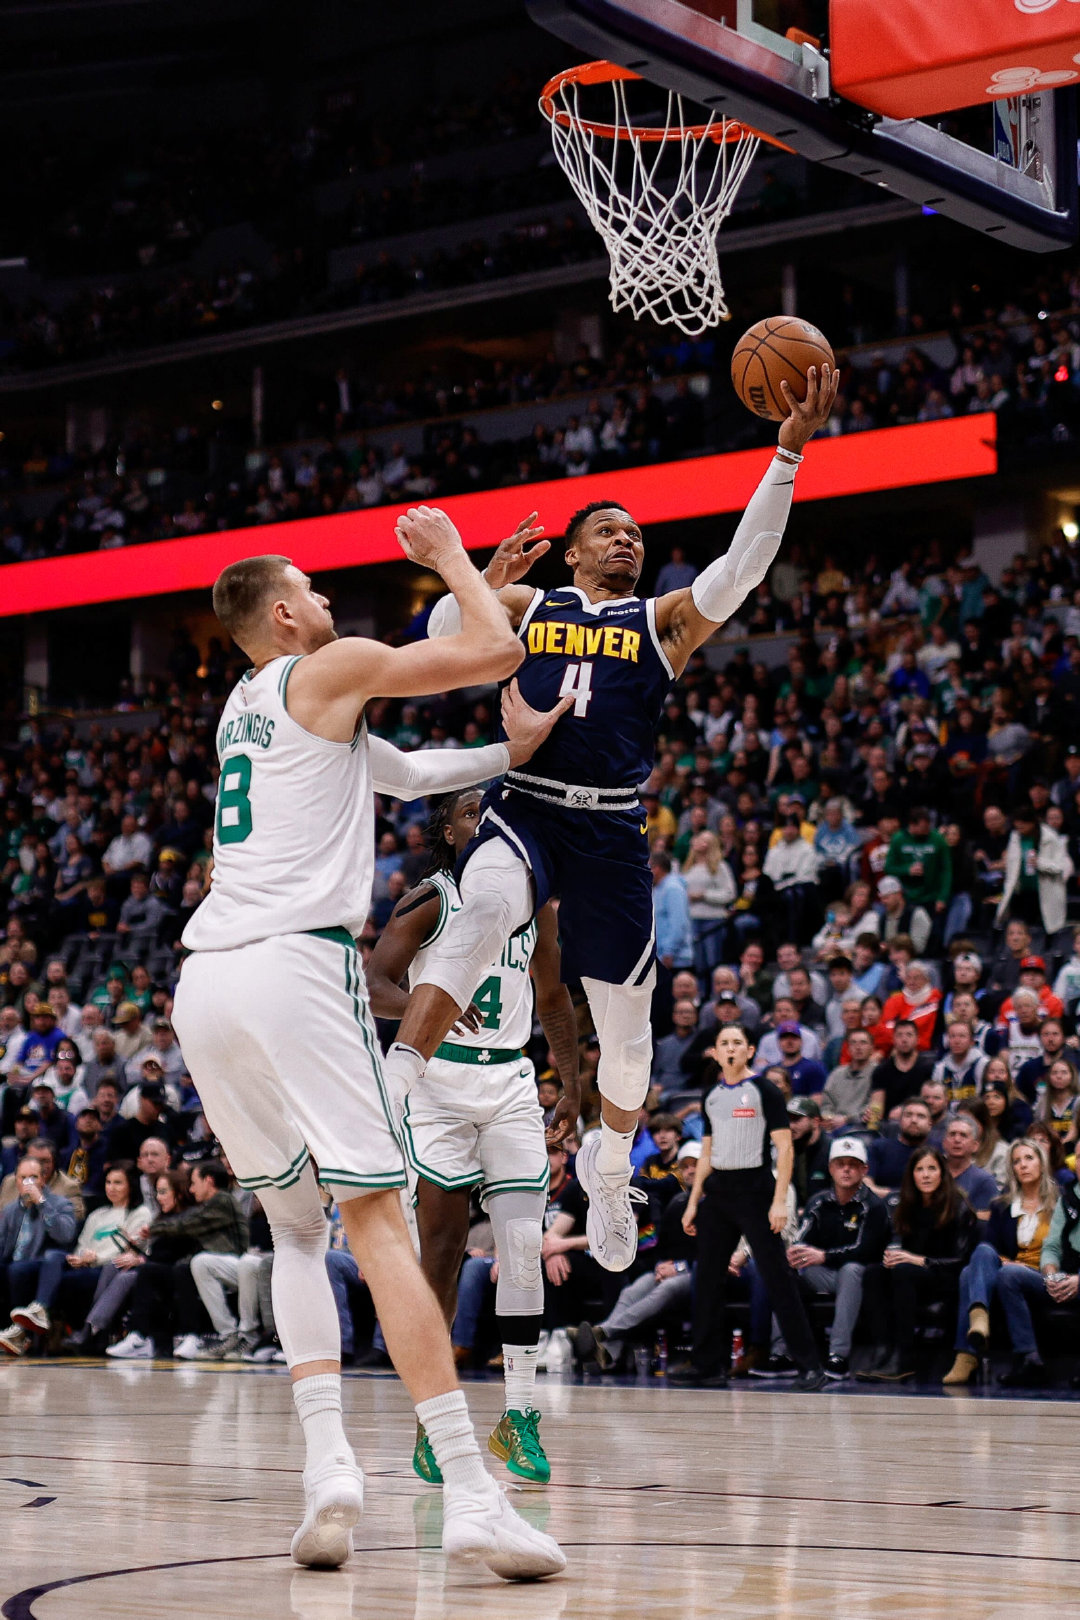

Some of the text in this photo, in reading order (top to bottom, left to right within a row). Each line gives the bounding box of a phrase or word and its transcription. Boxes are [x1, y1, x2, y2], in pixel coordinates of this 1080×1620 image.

[607, 607, 640, 616] ibotta
[527, 620, 641, 663] DENVER
[558, 661, 594, 718] 4
[219, 712, 275, 752] ORZINGIS
[216, 753, 253, 846] 8
[471, 975, 502, 1030] 4
